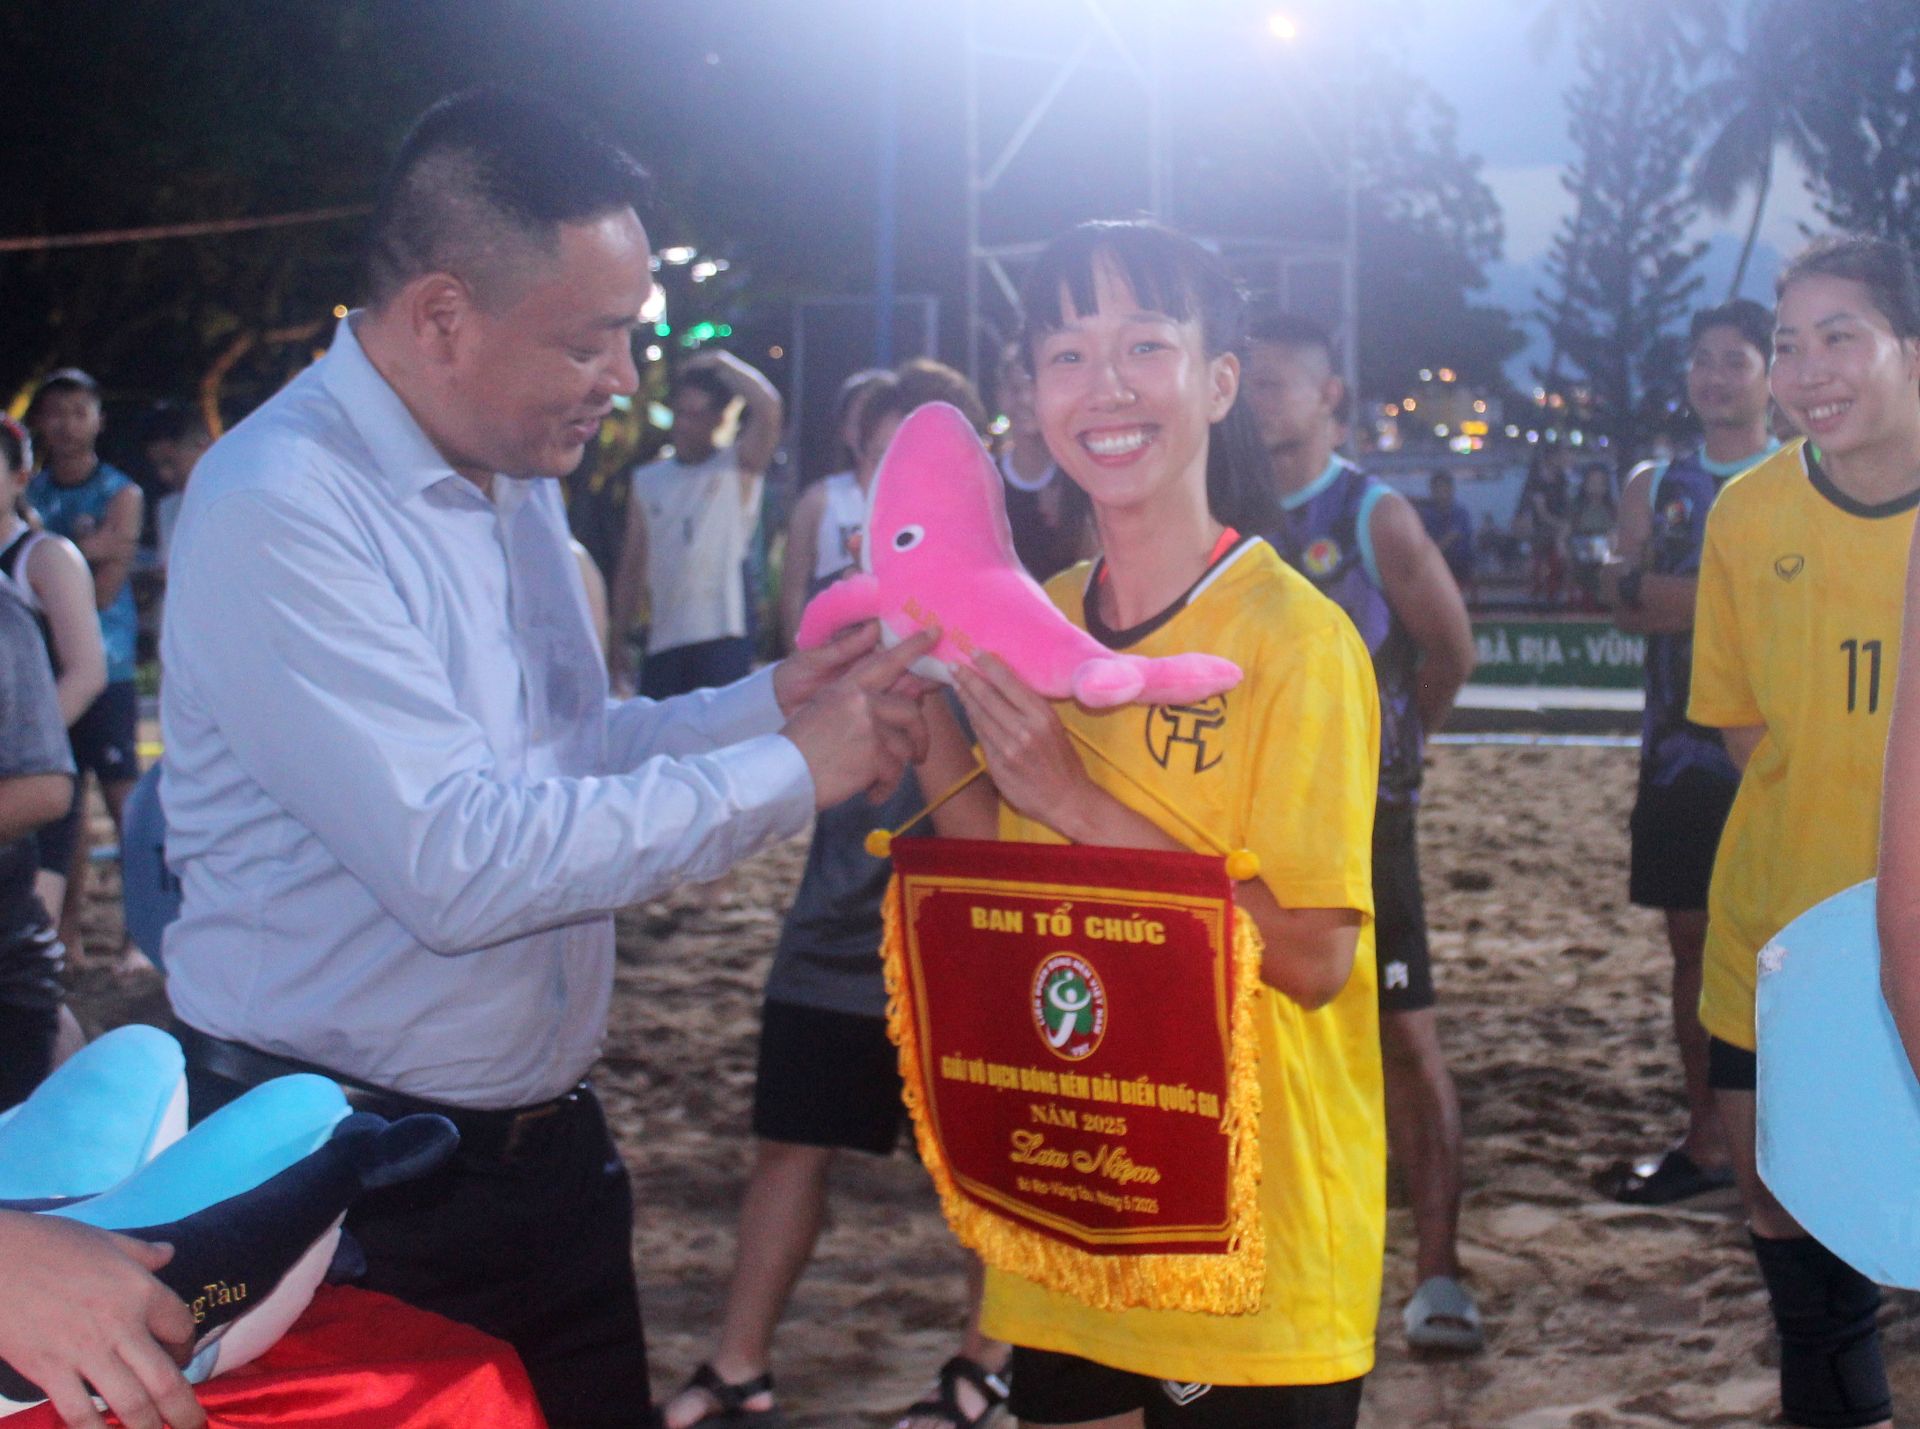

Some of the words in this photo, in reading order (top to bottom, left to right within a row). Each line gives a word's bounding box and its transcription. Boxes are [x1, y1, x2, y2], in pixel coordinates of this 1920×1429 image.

[1585, 628, 1646, 666] VŨN
[1840, 638, 1882, 715] 11
[971, 906, 1024, 933] BAN
[1034, 902, 1074, 937] TỔ
[1084, 912, 1166, 945] CHỨC
[1058, 1069, 1090, 1100] NÉM
[1156, 1082, 1197, 1114] QUỐC
[1029, 1101, 1079, 1129] NĂM
[1081, 1113, 1128, 1136] 2025
